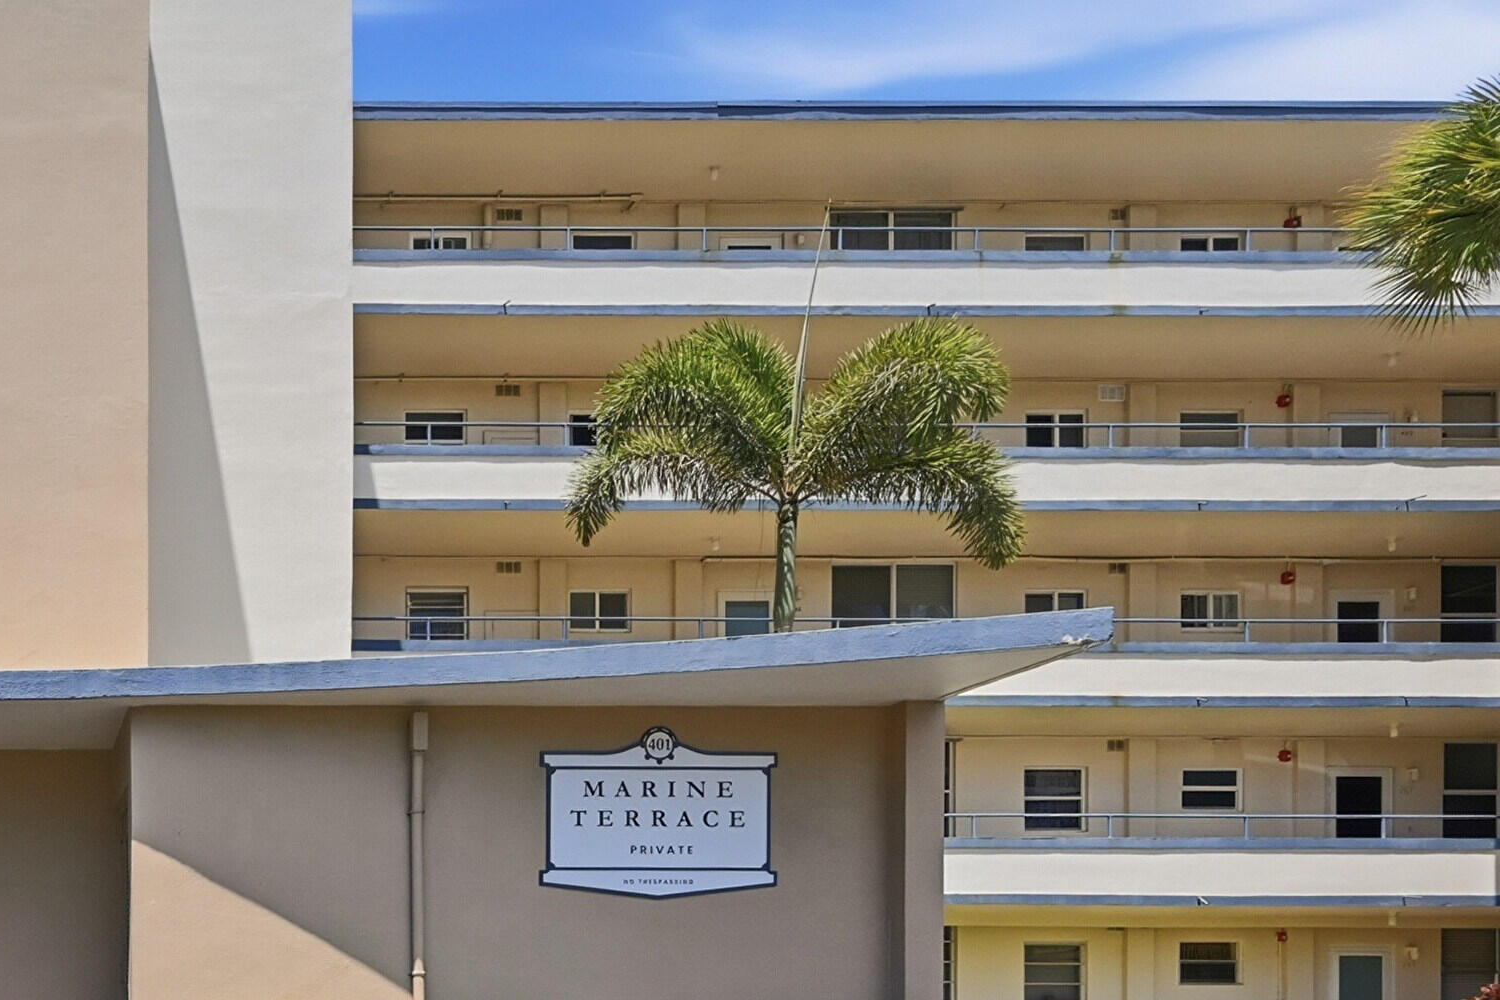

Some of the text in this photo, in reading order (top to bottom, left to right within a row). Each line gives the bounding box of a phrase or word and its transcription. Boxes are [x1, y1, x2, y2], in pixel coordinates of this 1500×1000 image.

[648, 738, 672, 751] 401
[583, 781, 734, 798] MARINE
[570, 810, 746, 828] TERRACE
[630, 845, 694, 855] PRIVATE
